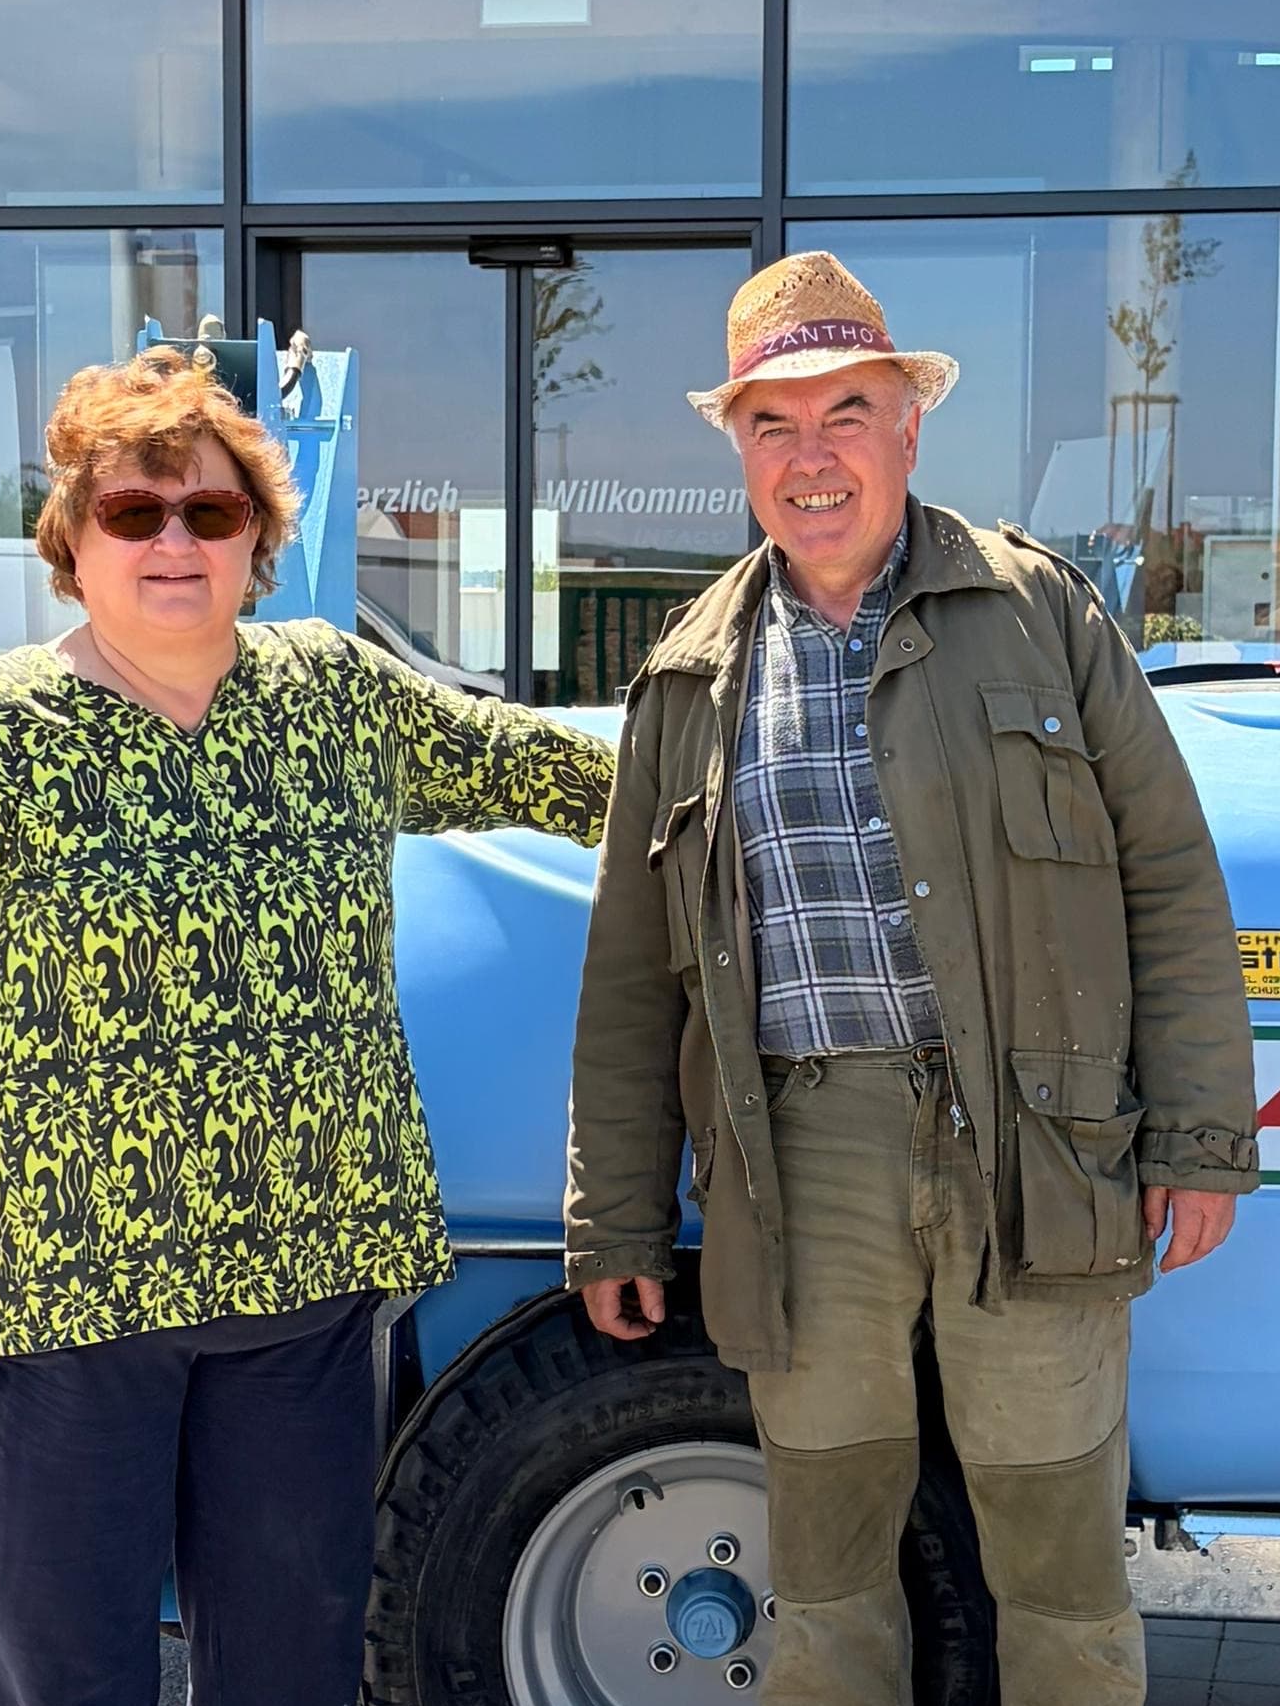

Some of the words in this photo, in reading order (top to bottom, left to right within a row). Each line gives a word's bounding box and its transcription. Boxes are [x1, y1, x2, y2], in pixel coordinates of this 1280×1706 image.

[763, 324, 874, 355] ZANTHO
[357, 479, 459, 514] erzlich
[546, 479, 748, 514] Willkommen
